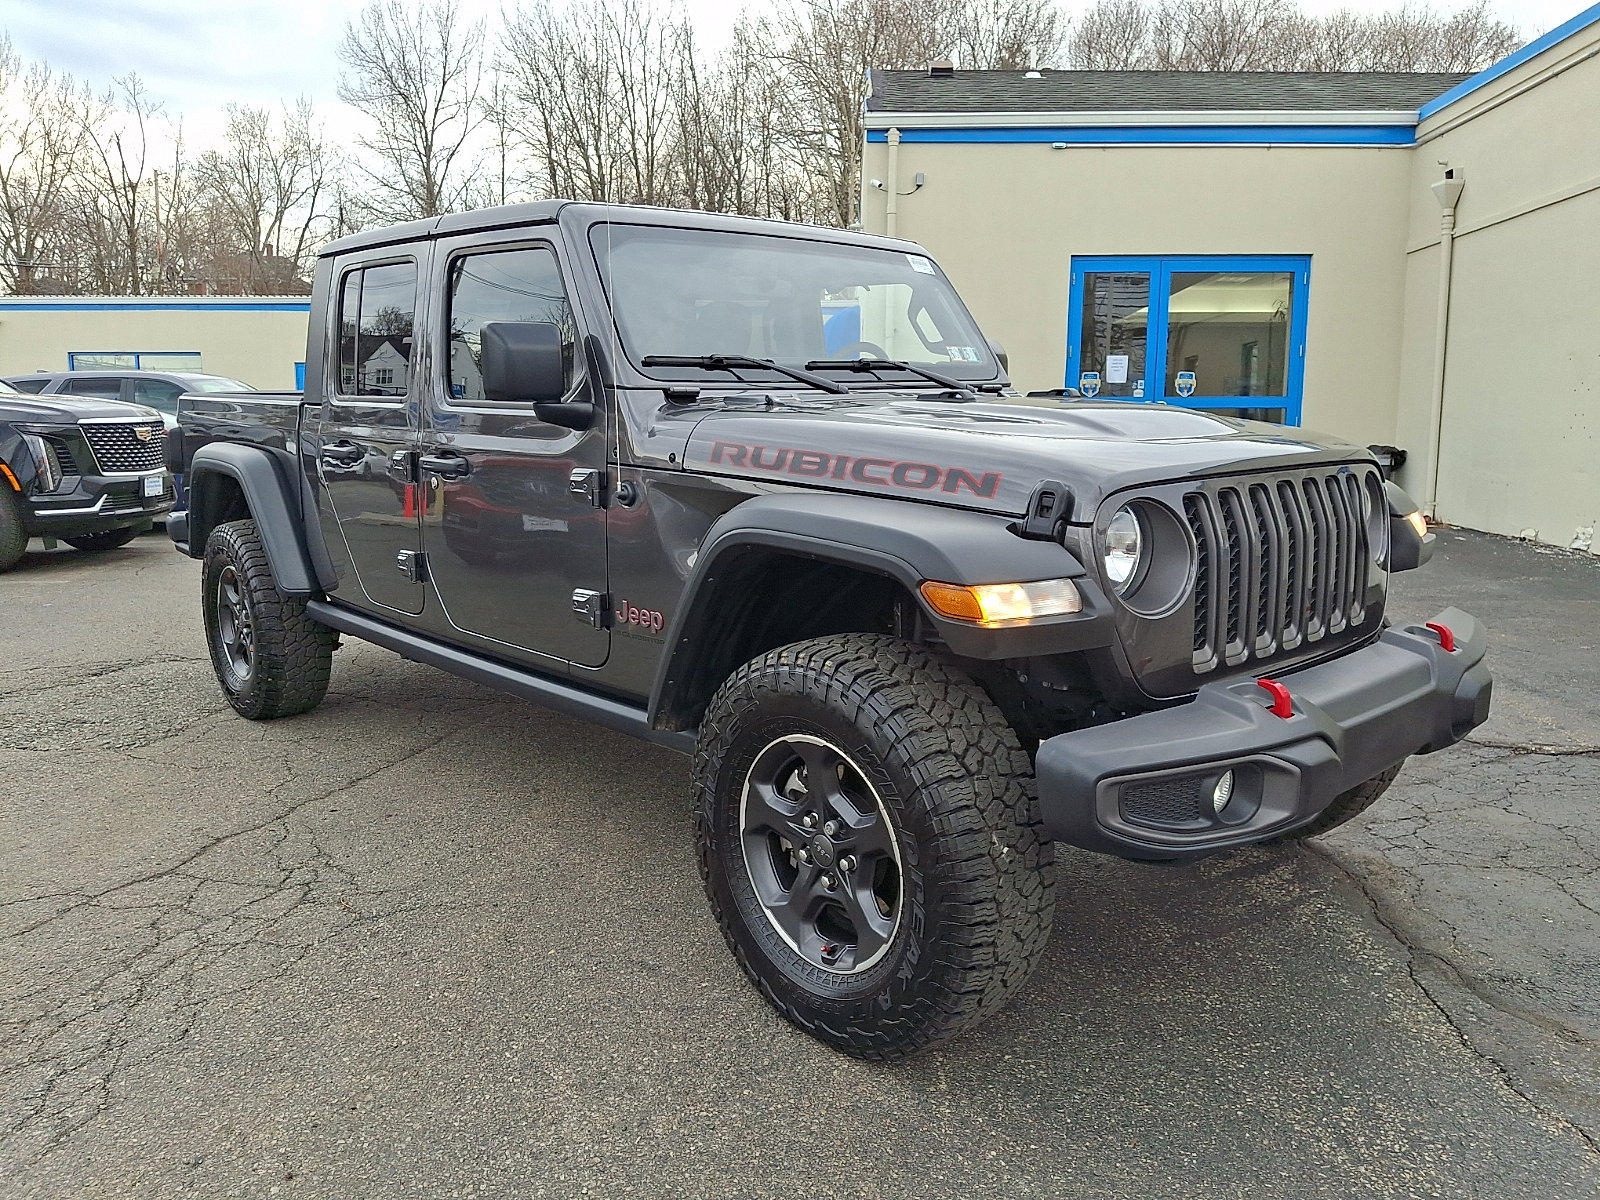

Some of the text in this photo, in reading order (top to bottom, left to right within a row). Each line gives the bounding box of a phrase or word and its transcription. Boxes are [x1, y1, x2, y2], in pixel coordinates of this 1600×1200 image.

[709, 440, 1002, 499] RUBICON
[616, 599, 664, 634] Jeep
[854, 743, 926, 991] WILDPEAK
